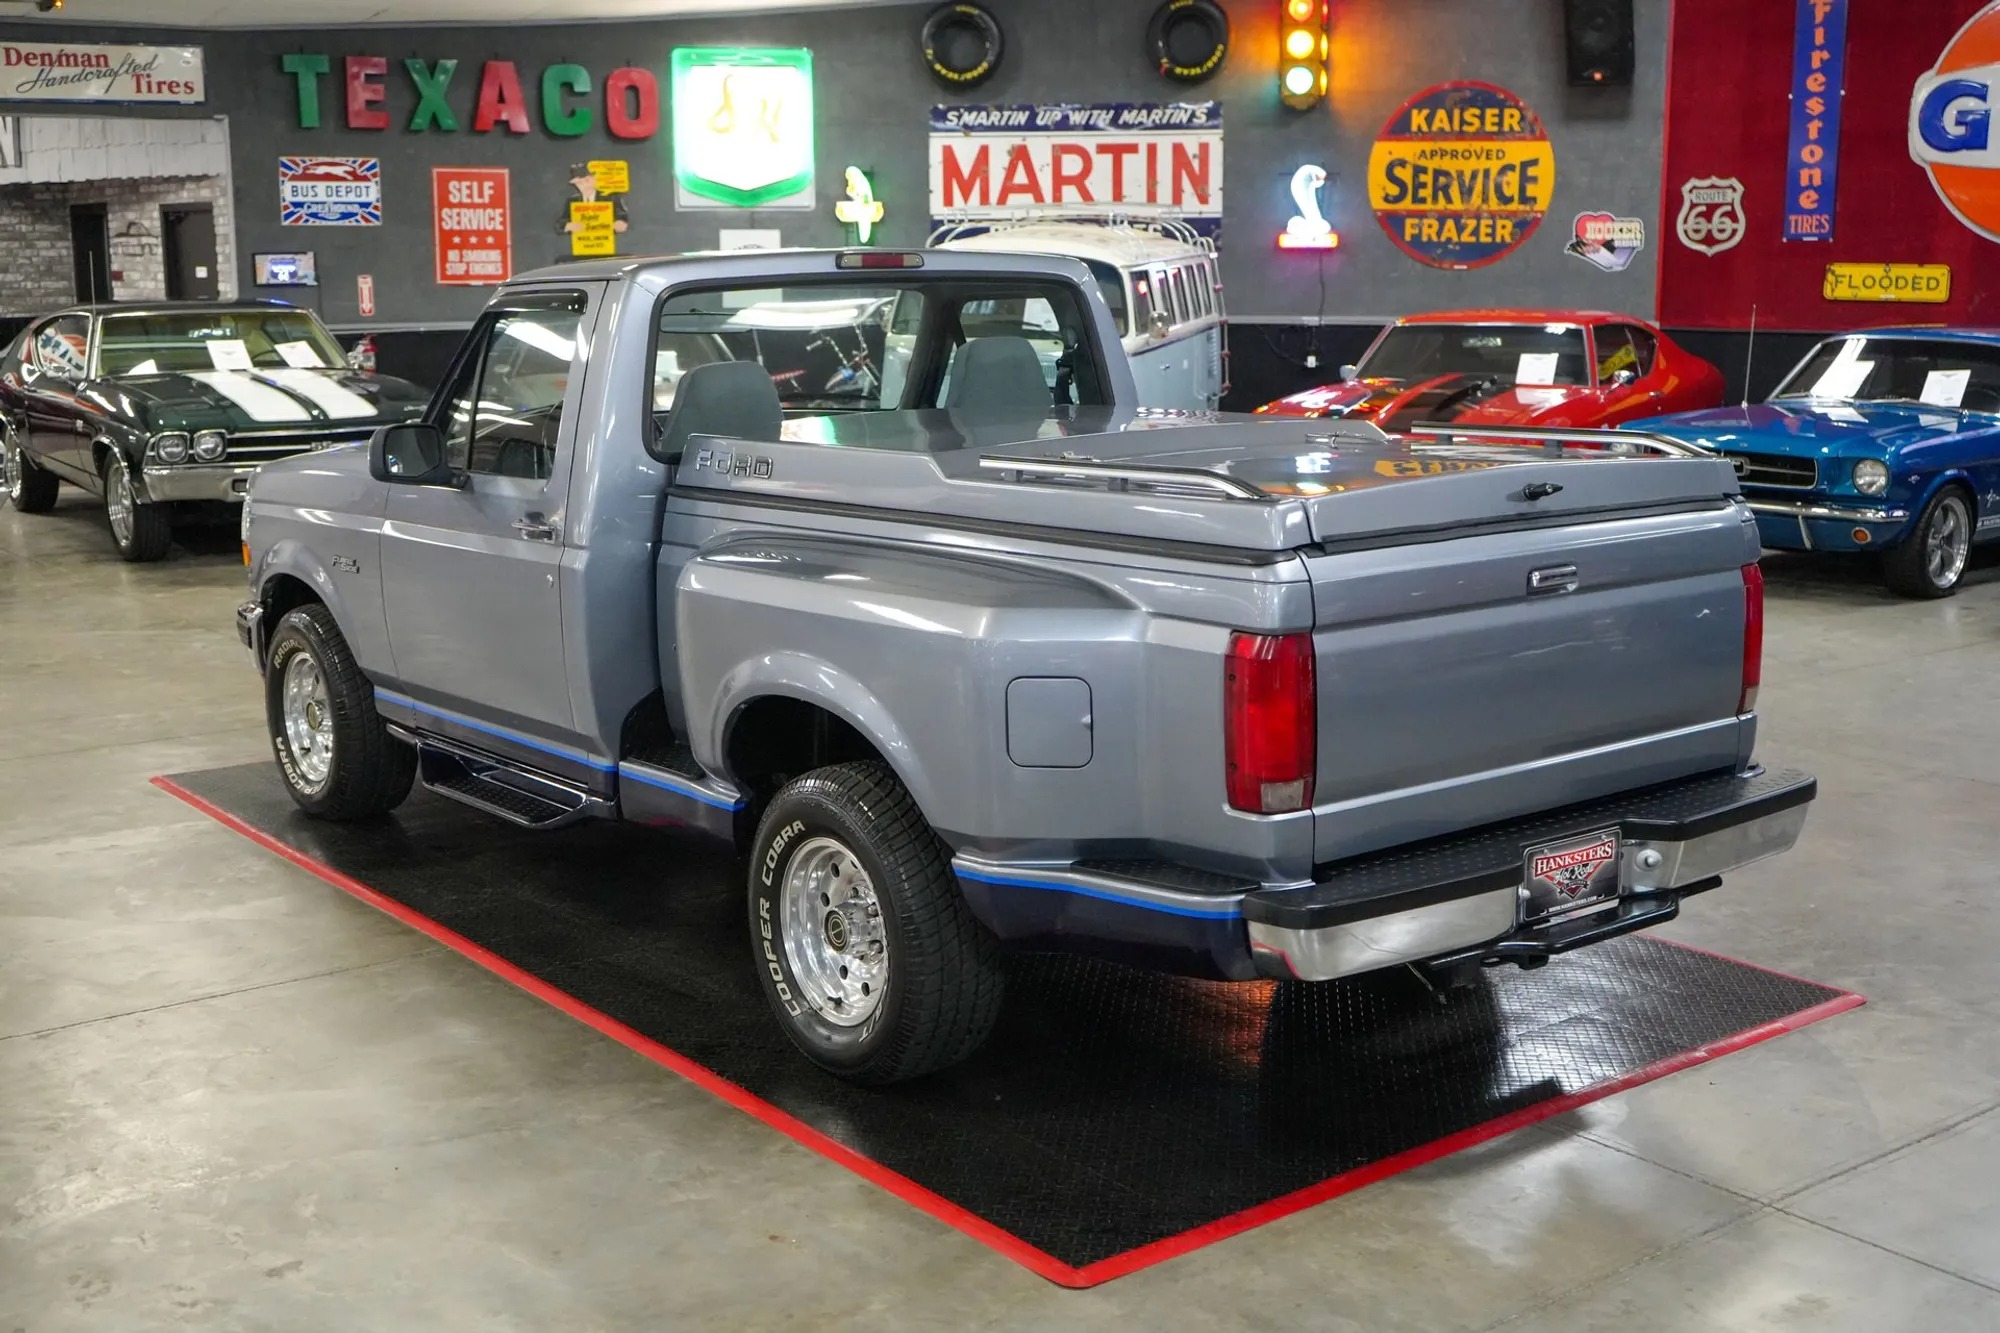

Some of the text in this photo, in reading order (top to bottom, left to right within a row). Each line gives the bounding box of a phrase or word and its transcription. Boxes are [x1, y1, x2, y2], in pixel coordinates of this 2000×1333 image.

[3, 47, 109, 68] Denman
[16, 50, 158, 94] Handcrafted
[132, 73, 195, 96] Tires
[282, 54, 659, 139] TEXACO
[1799, 0, 1831, 209] Firestone
[1036, 111, 1062, 125] UP
[1069, 110, 1111, 125] WITH
[1411, 108, 1522, 133] KAISER
[1918, 79, 1991, 153] G
[1418, 148, 1506, 160] APPROVED
[942, 142, 1209, 207] MARTIN
[1383, 158, 1540, 205] SERVICE
[291, 185, 371, 197] BUS DEPOT
[448, 180, 494, 203] SELF
[1694, 190, 1729, 201] ROUTE
[441, 208, 504, 231] SERVICE
[1404, 218, 1513, 243] FRAZER
[1685, 205, 1734, 240] 66
[1789, 214, 1830, 234] TIRES
[1834, 274, 1940, 292] FLOODED
[696, 449, 773, 479] FORD
[275, 736, 305, 790] COBRA
[1536, 842, 1612, 875] HANKSTERS
[760, 820, 805, 1017] COOPER COBRA
